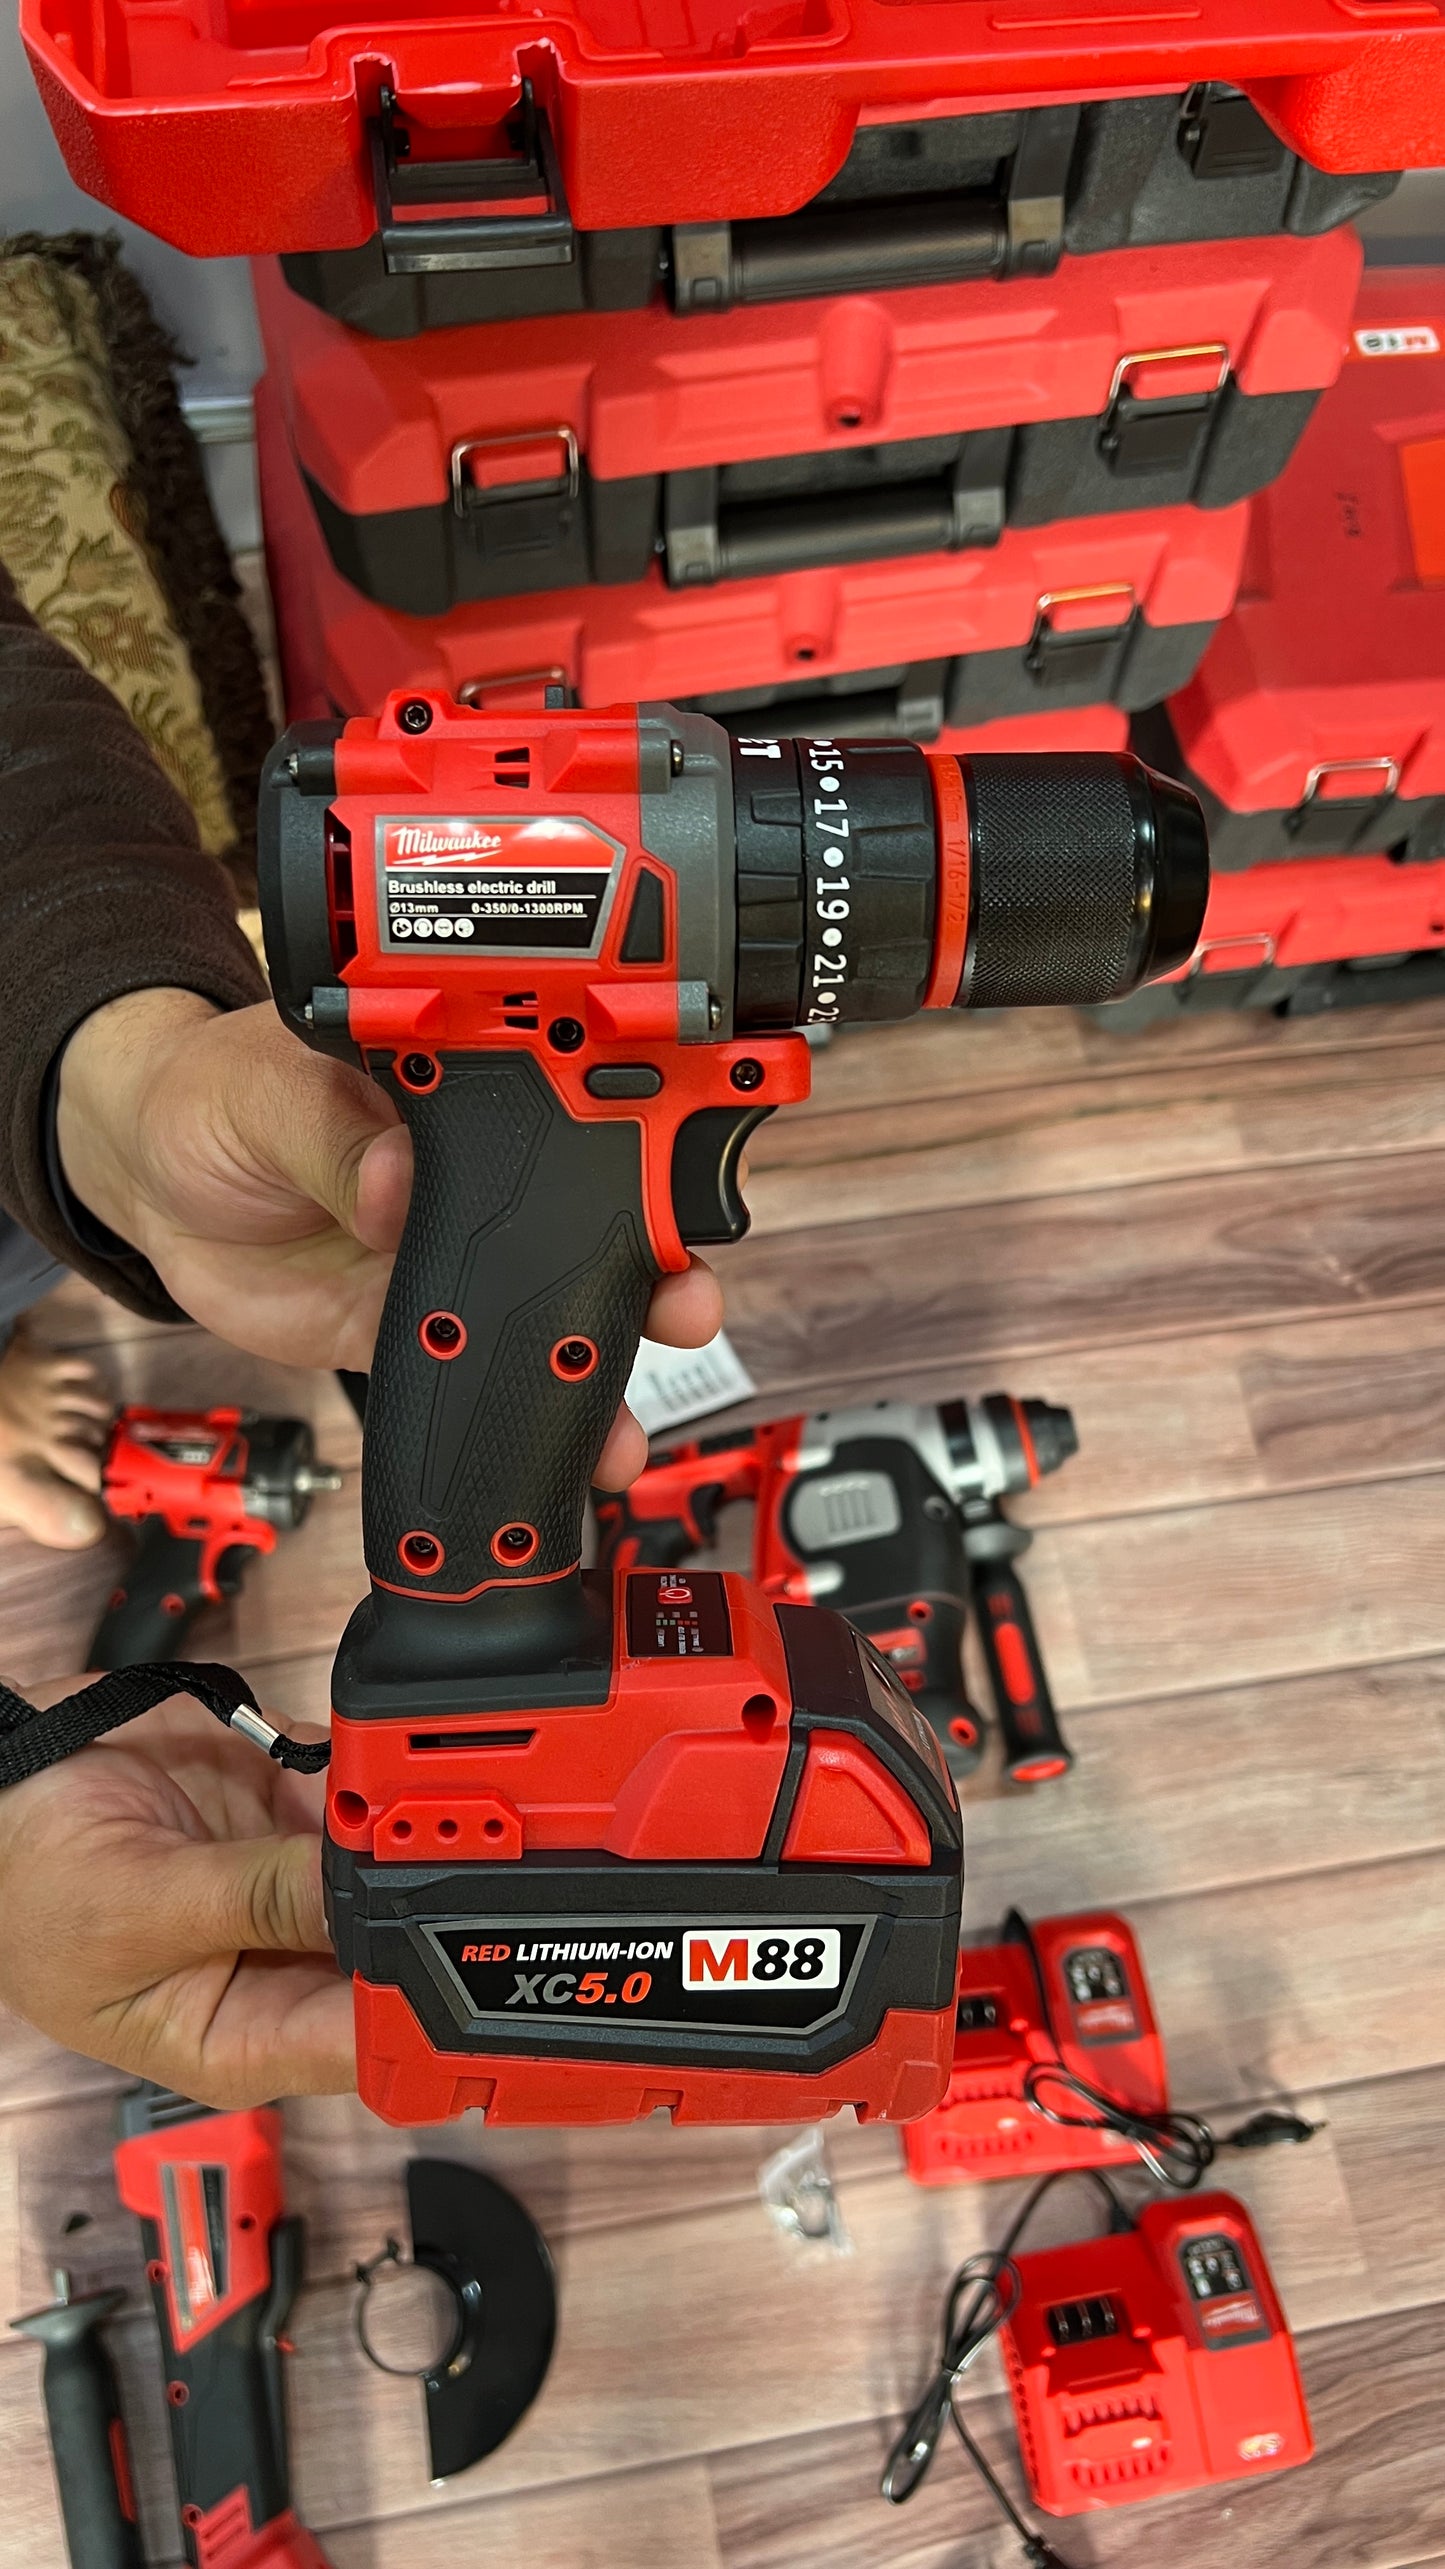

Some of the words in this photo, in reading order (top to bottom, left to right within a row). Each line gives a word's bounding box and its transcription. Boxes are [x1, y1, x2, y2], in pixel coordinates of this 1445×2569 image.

[809, 748, 844, 771] 15
[814, 798, 850, 838] 17
[390, 826, 502, 855] Milwaukee
[387, 880, 464, 894] Brushless
[468, 880, 524, 894] electric
[527, 880, 556, 894] drill
[816, 876, 850, 920] 19
[389, 902, 439, 915] Ø13mm
[471, 902, 584, 914] 0-350/0-1300RPM
[812, 954, 847, 988] 21
[461, 1945, 511, 1962] RED
[516, 1942, 674, 1962] LITHIUM-ION
[689, 1937, 826, 1982] M88
[505, 1971, 652, 2005] XC5.0
